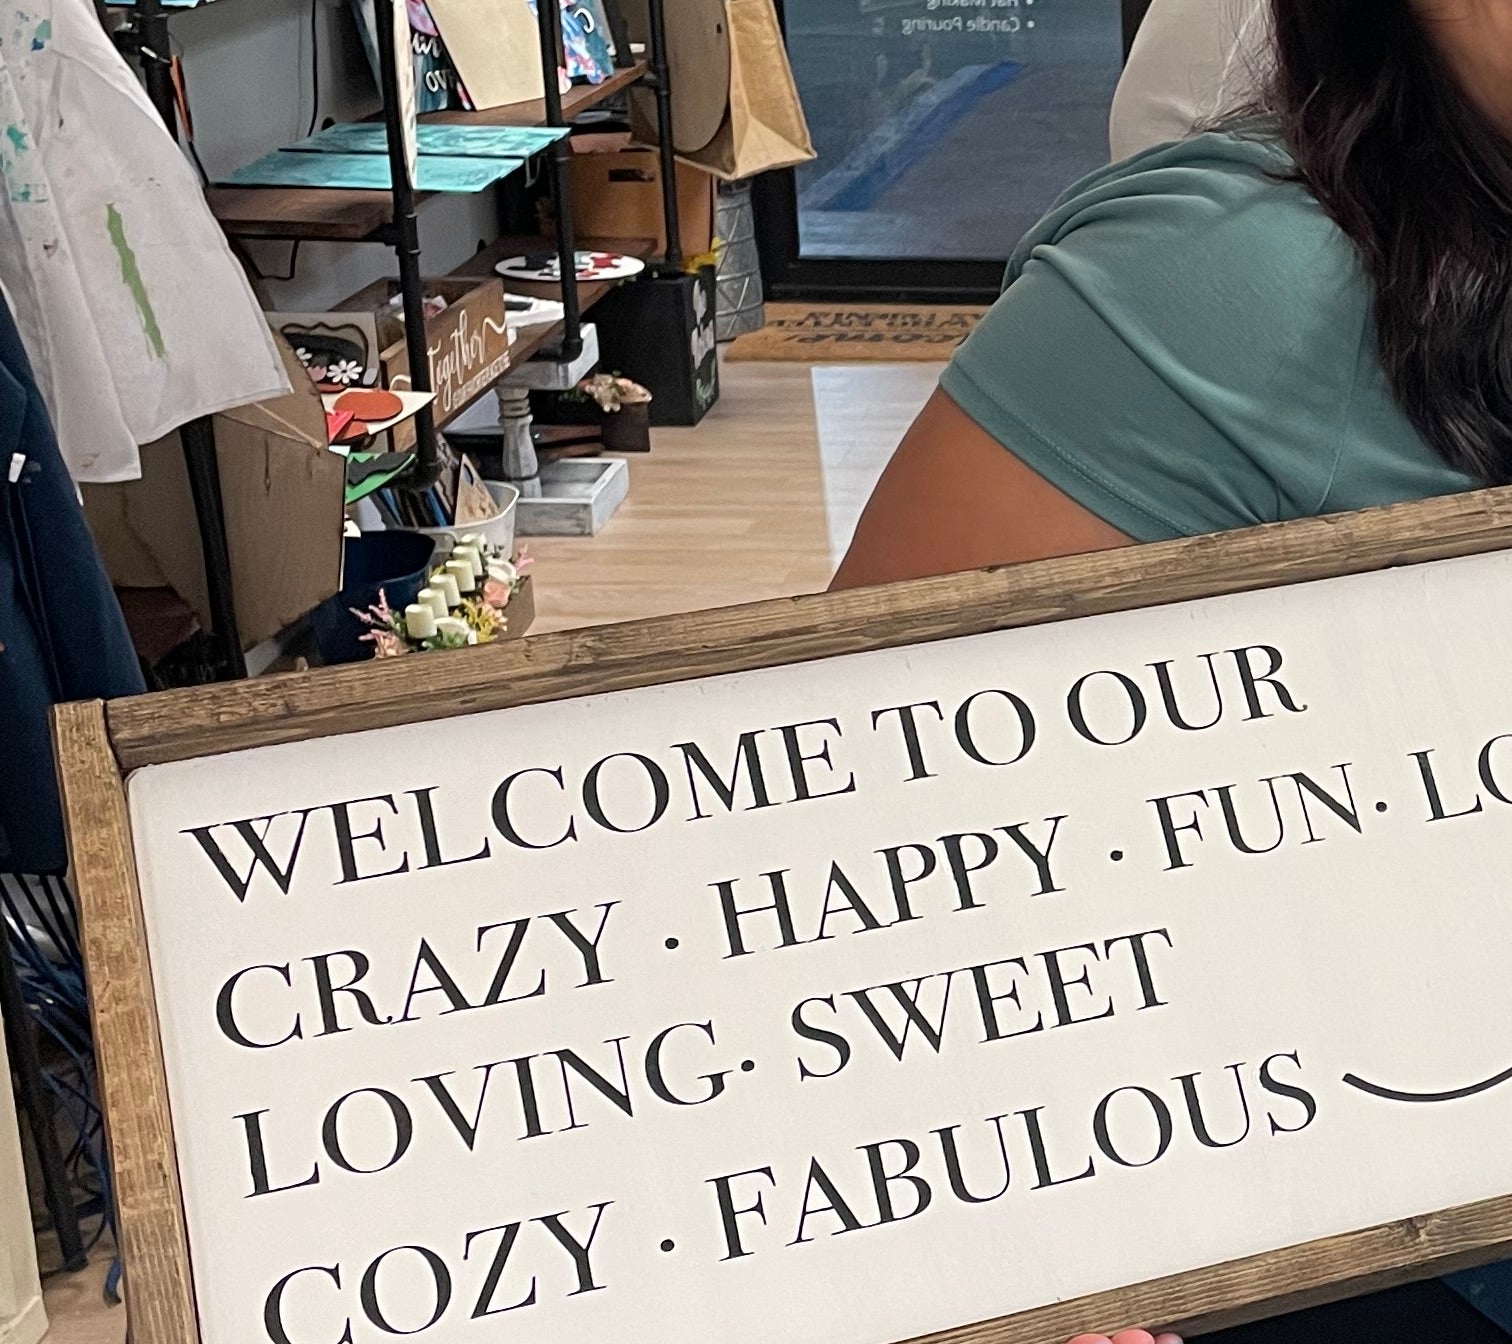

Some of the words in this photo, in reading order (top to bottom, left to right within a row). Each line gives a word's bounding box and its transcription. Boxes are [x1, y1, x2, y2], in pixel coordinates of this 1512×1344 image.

[179, 718, 856, 904] WELCOME
[871, 689, 1036, 782] TO
[1066, 644, 1309, 746] OUR
[215, 900, 622, 1049] CRAZY
[708, 814, 1069, 960] HAPPY
[791, 928, 1174, 1083] SWEET
[704, 1049, 1318, 1263] FABULOUS
